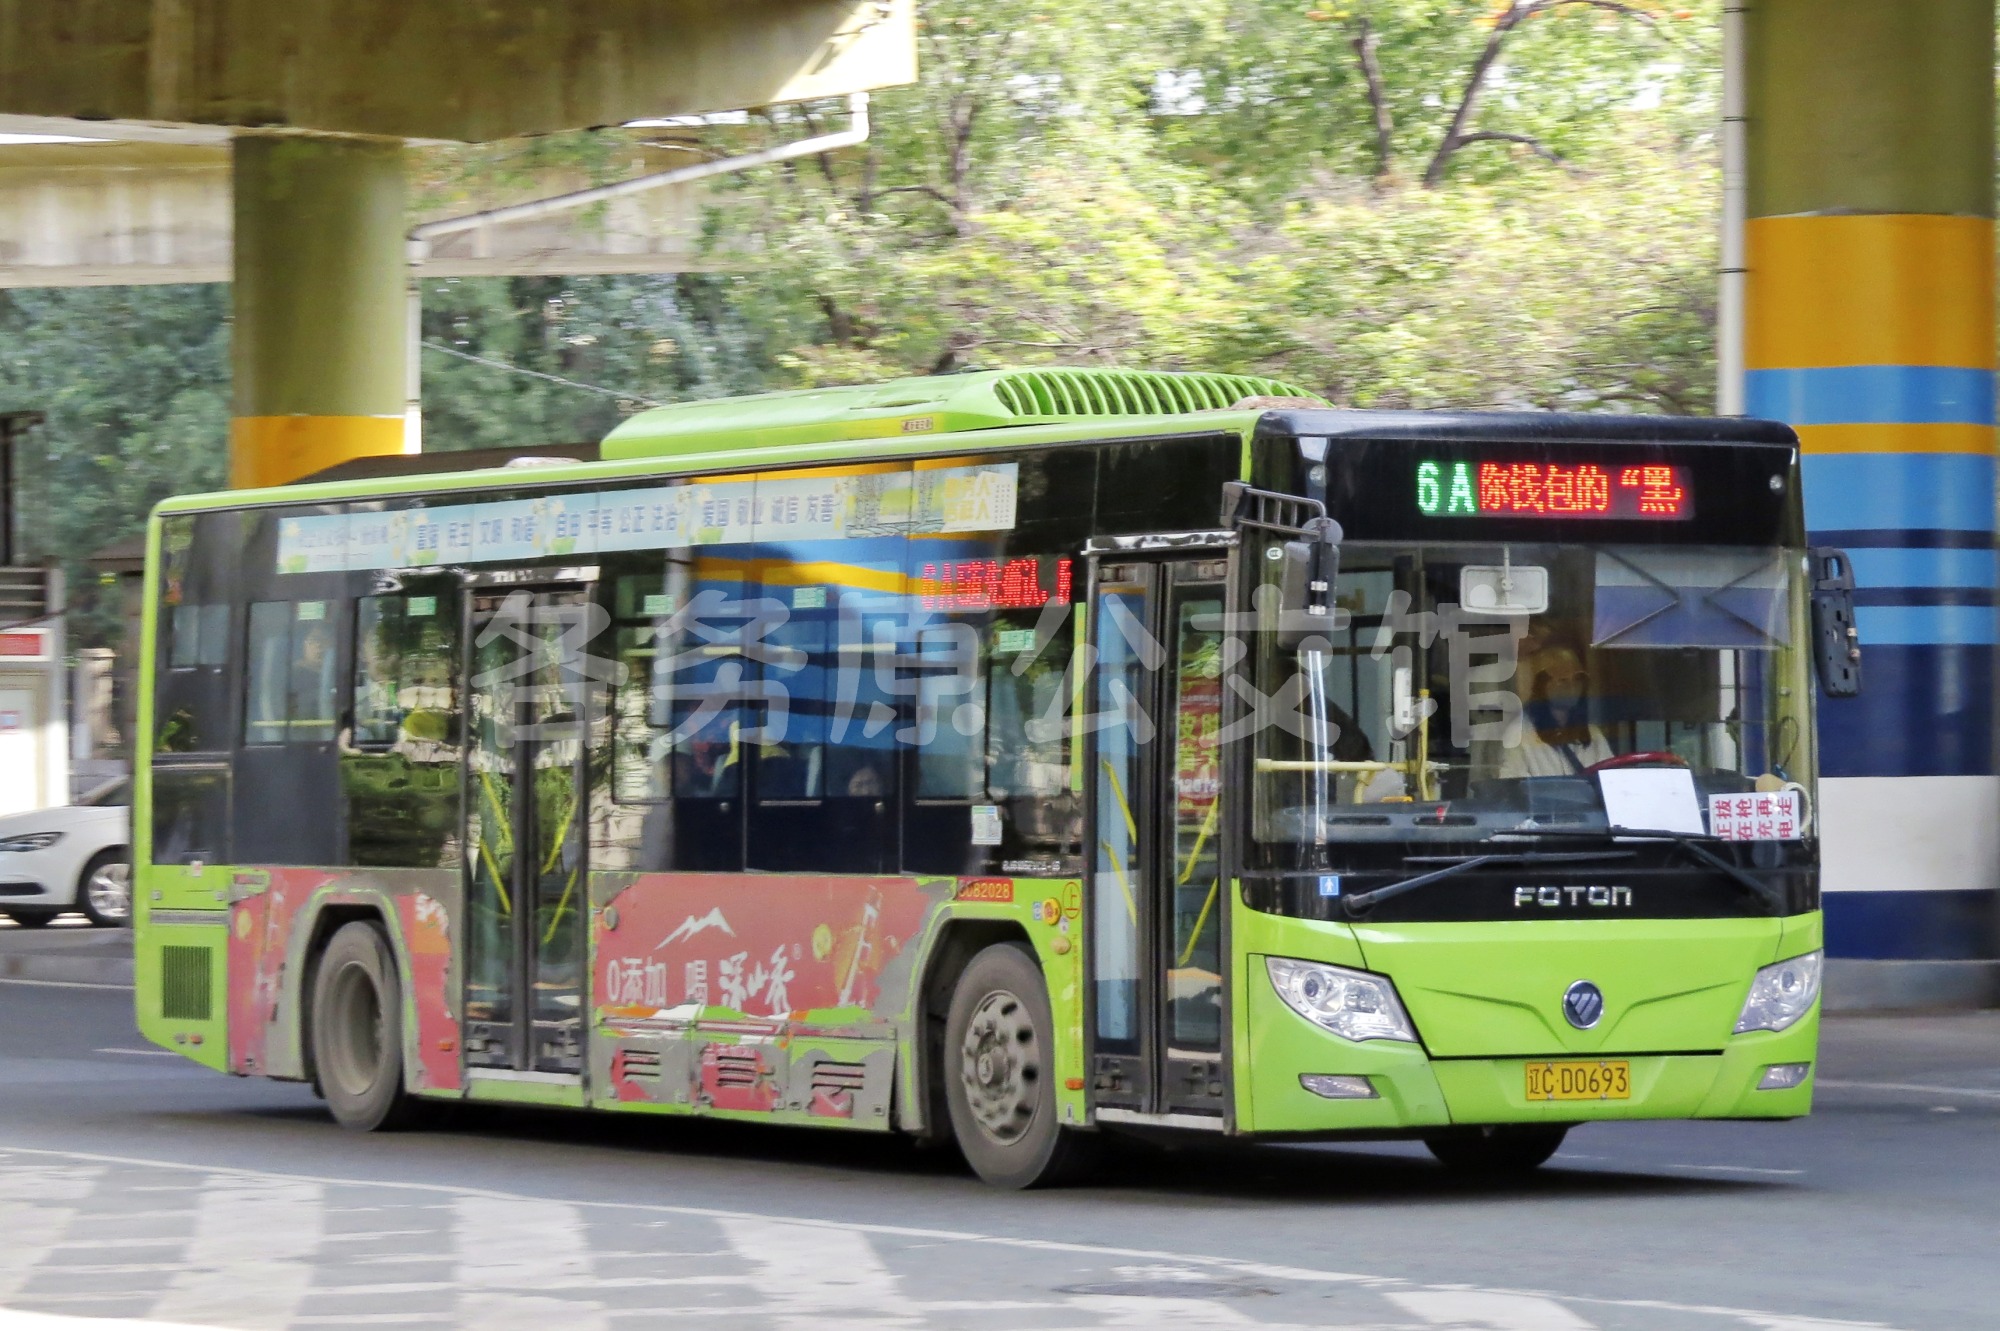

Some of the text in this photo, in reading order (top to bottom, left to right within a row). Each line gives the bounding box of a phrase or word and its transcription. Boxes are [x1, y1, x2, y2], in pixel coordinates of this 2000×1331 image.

[1417, 462, 1475, 513] 6A
[1716, 819, 1793, 841] 正在充电
[1515, 886, 1632, 907] FOTON
